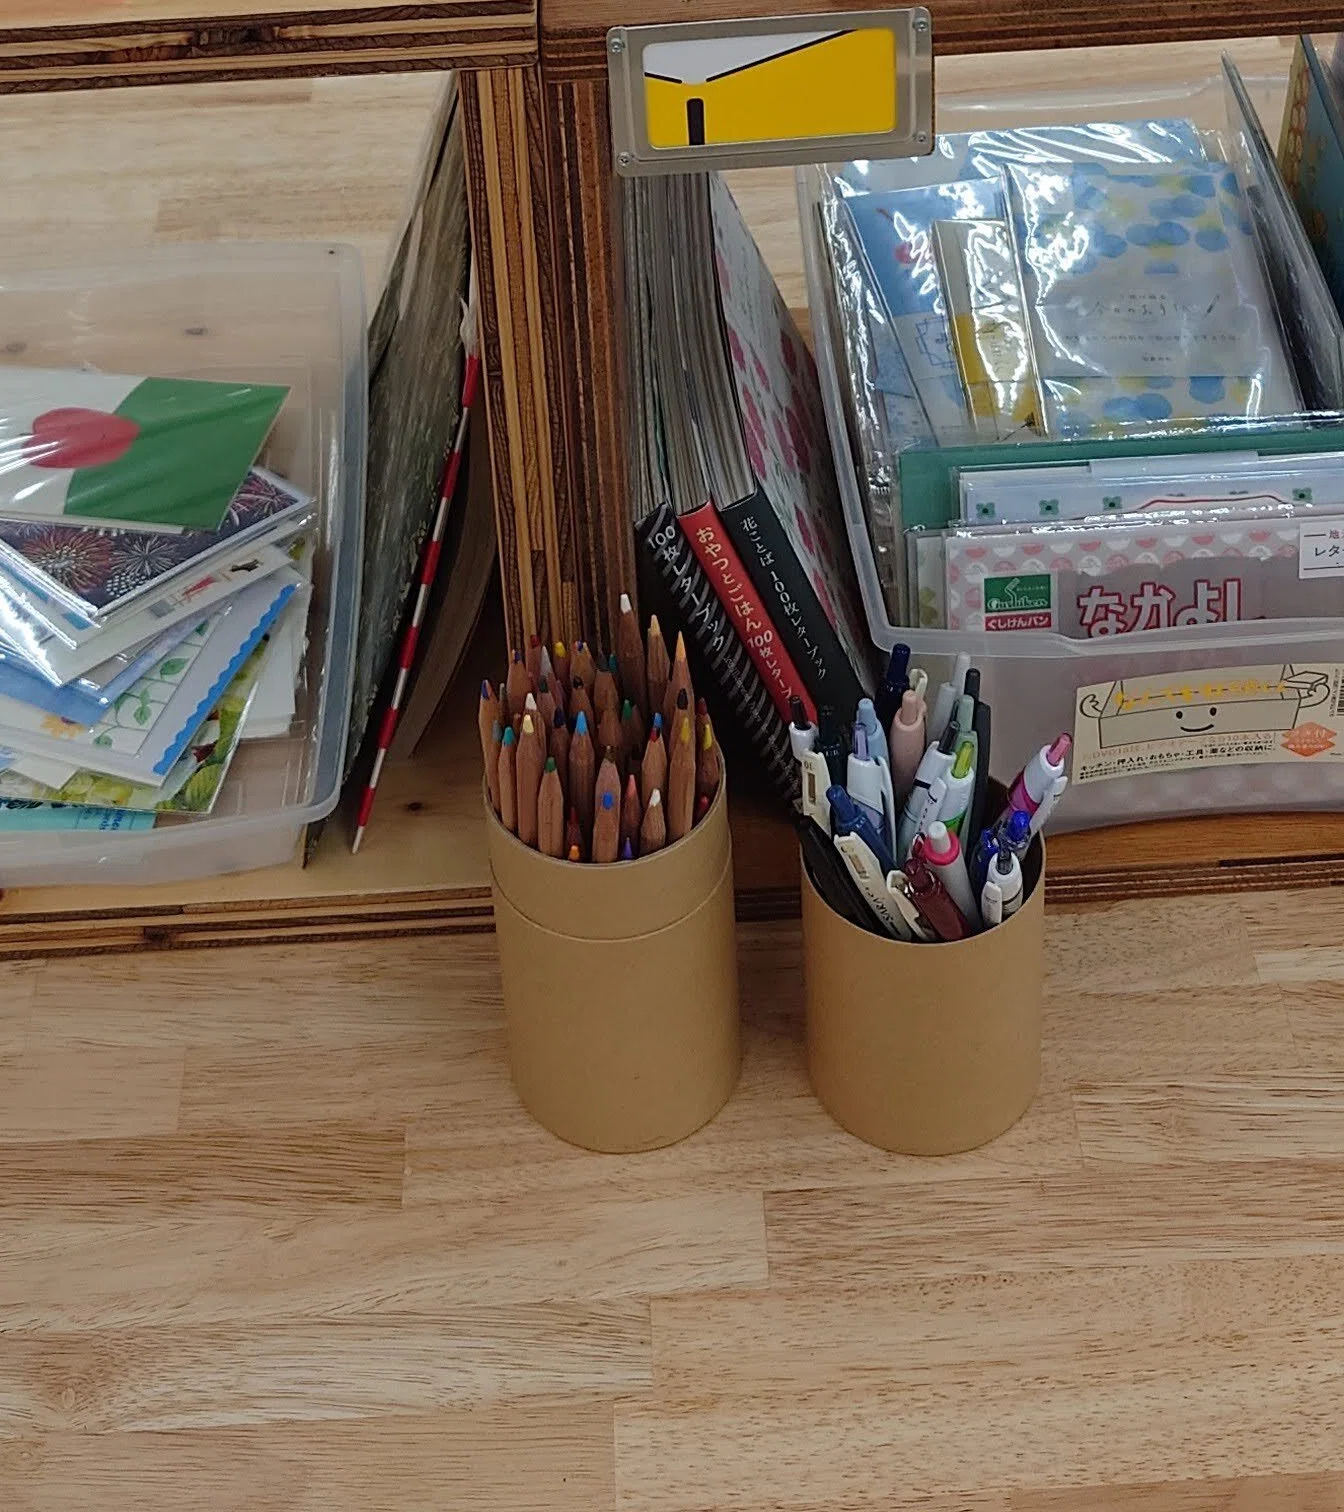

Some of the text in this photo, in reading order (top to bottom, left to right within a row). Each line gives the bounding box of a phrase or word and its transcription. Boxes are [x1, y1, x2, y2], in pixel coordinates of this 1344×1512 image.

[696, 526, 762, 634] おやつとごはん
[740, 515, 775, 568] 花ことば
